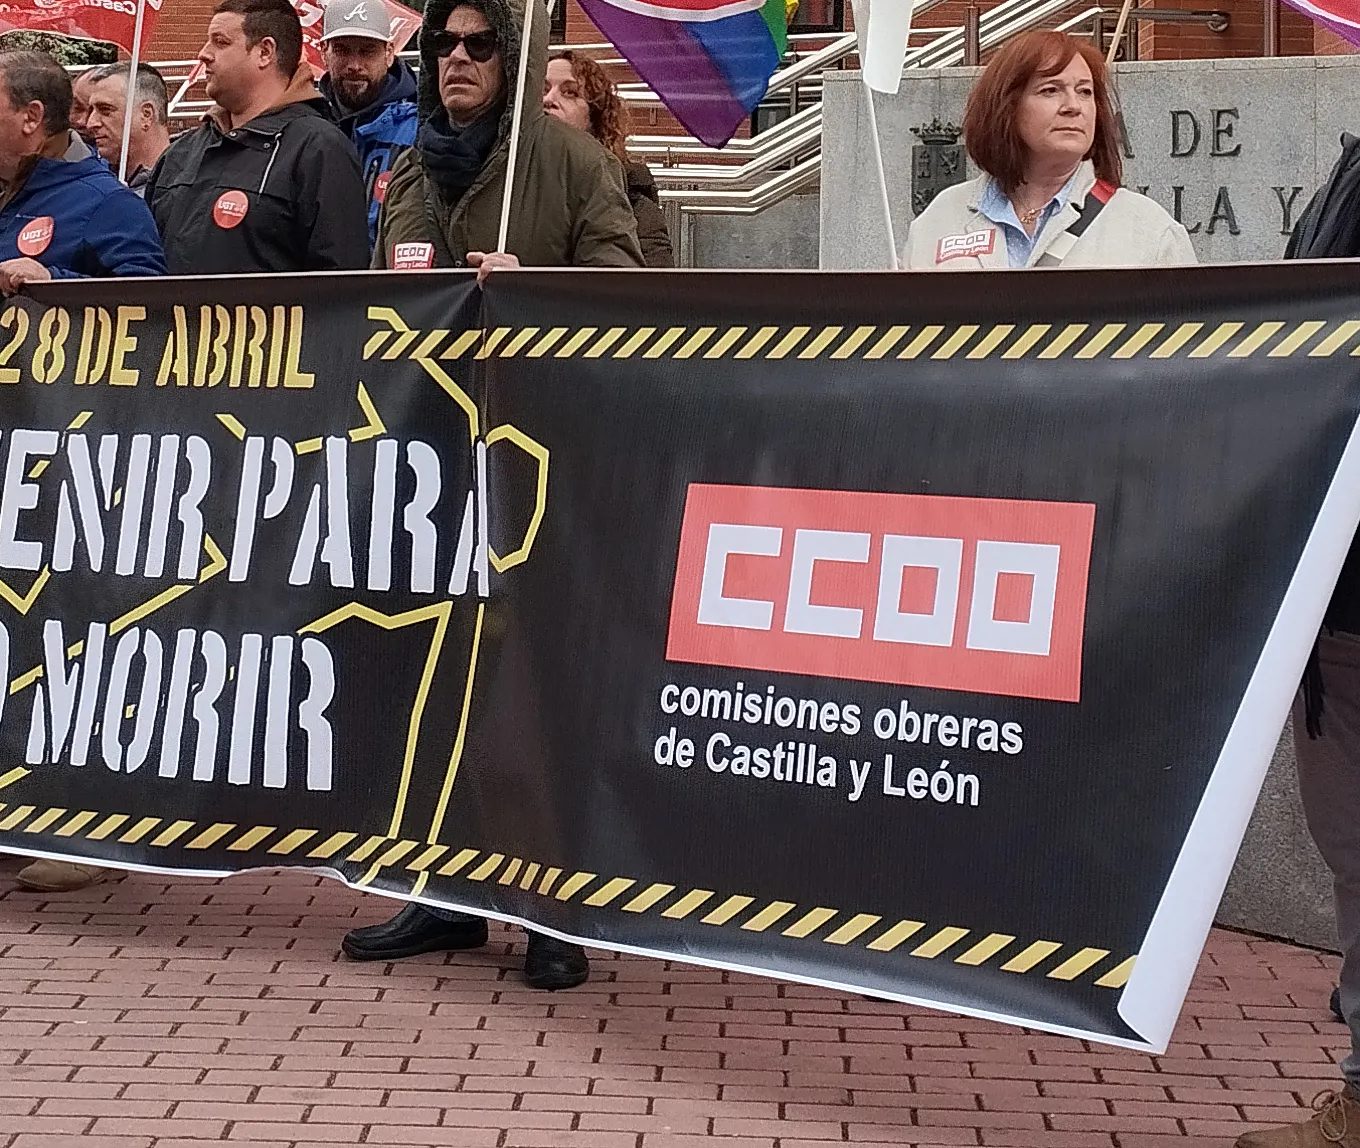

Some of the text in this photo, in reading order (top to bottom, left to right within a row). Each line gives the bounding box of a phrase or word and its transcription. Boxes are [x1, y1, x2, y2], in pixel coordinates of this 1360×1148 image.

[1169, 107, 1242, 157] DE
[944, 233, 986, 249] CCOO
[1271, 186, 1303, 235] Y
[396, 246, 427, 258] CCOO
[74, 307, 147, 388] DE
[156, 305, 317, 390] ABRIL
[228, 434, 490, 598] PARA
[697, 523, 1060, 656] CCOO
[26, 618, 336, 791] MORIR
[660, 682, 1024, 755] comisiones obreras
[654, 727, 981, 807] de Castilla y León
